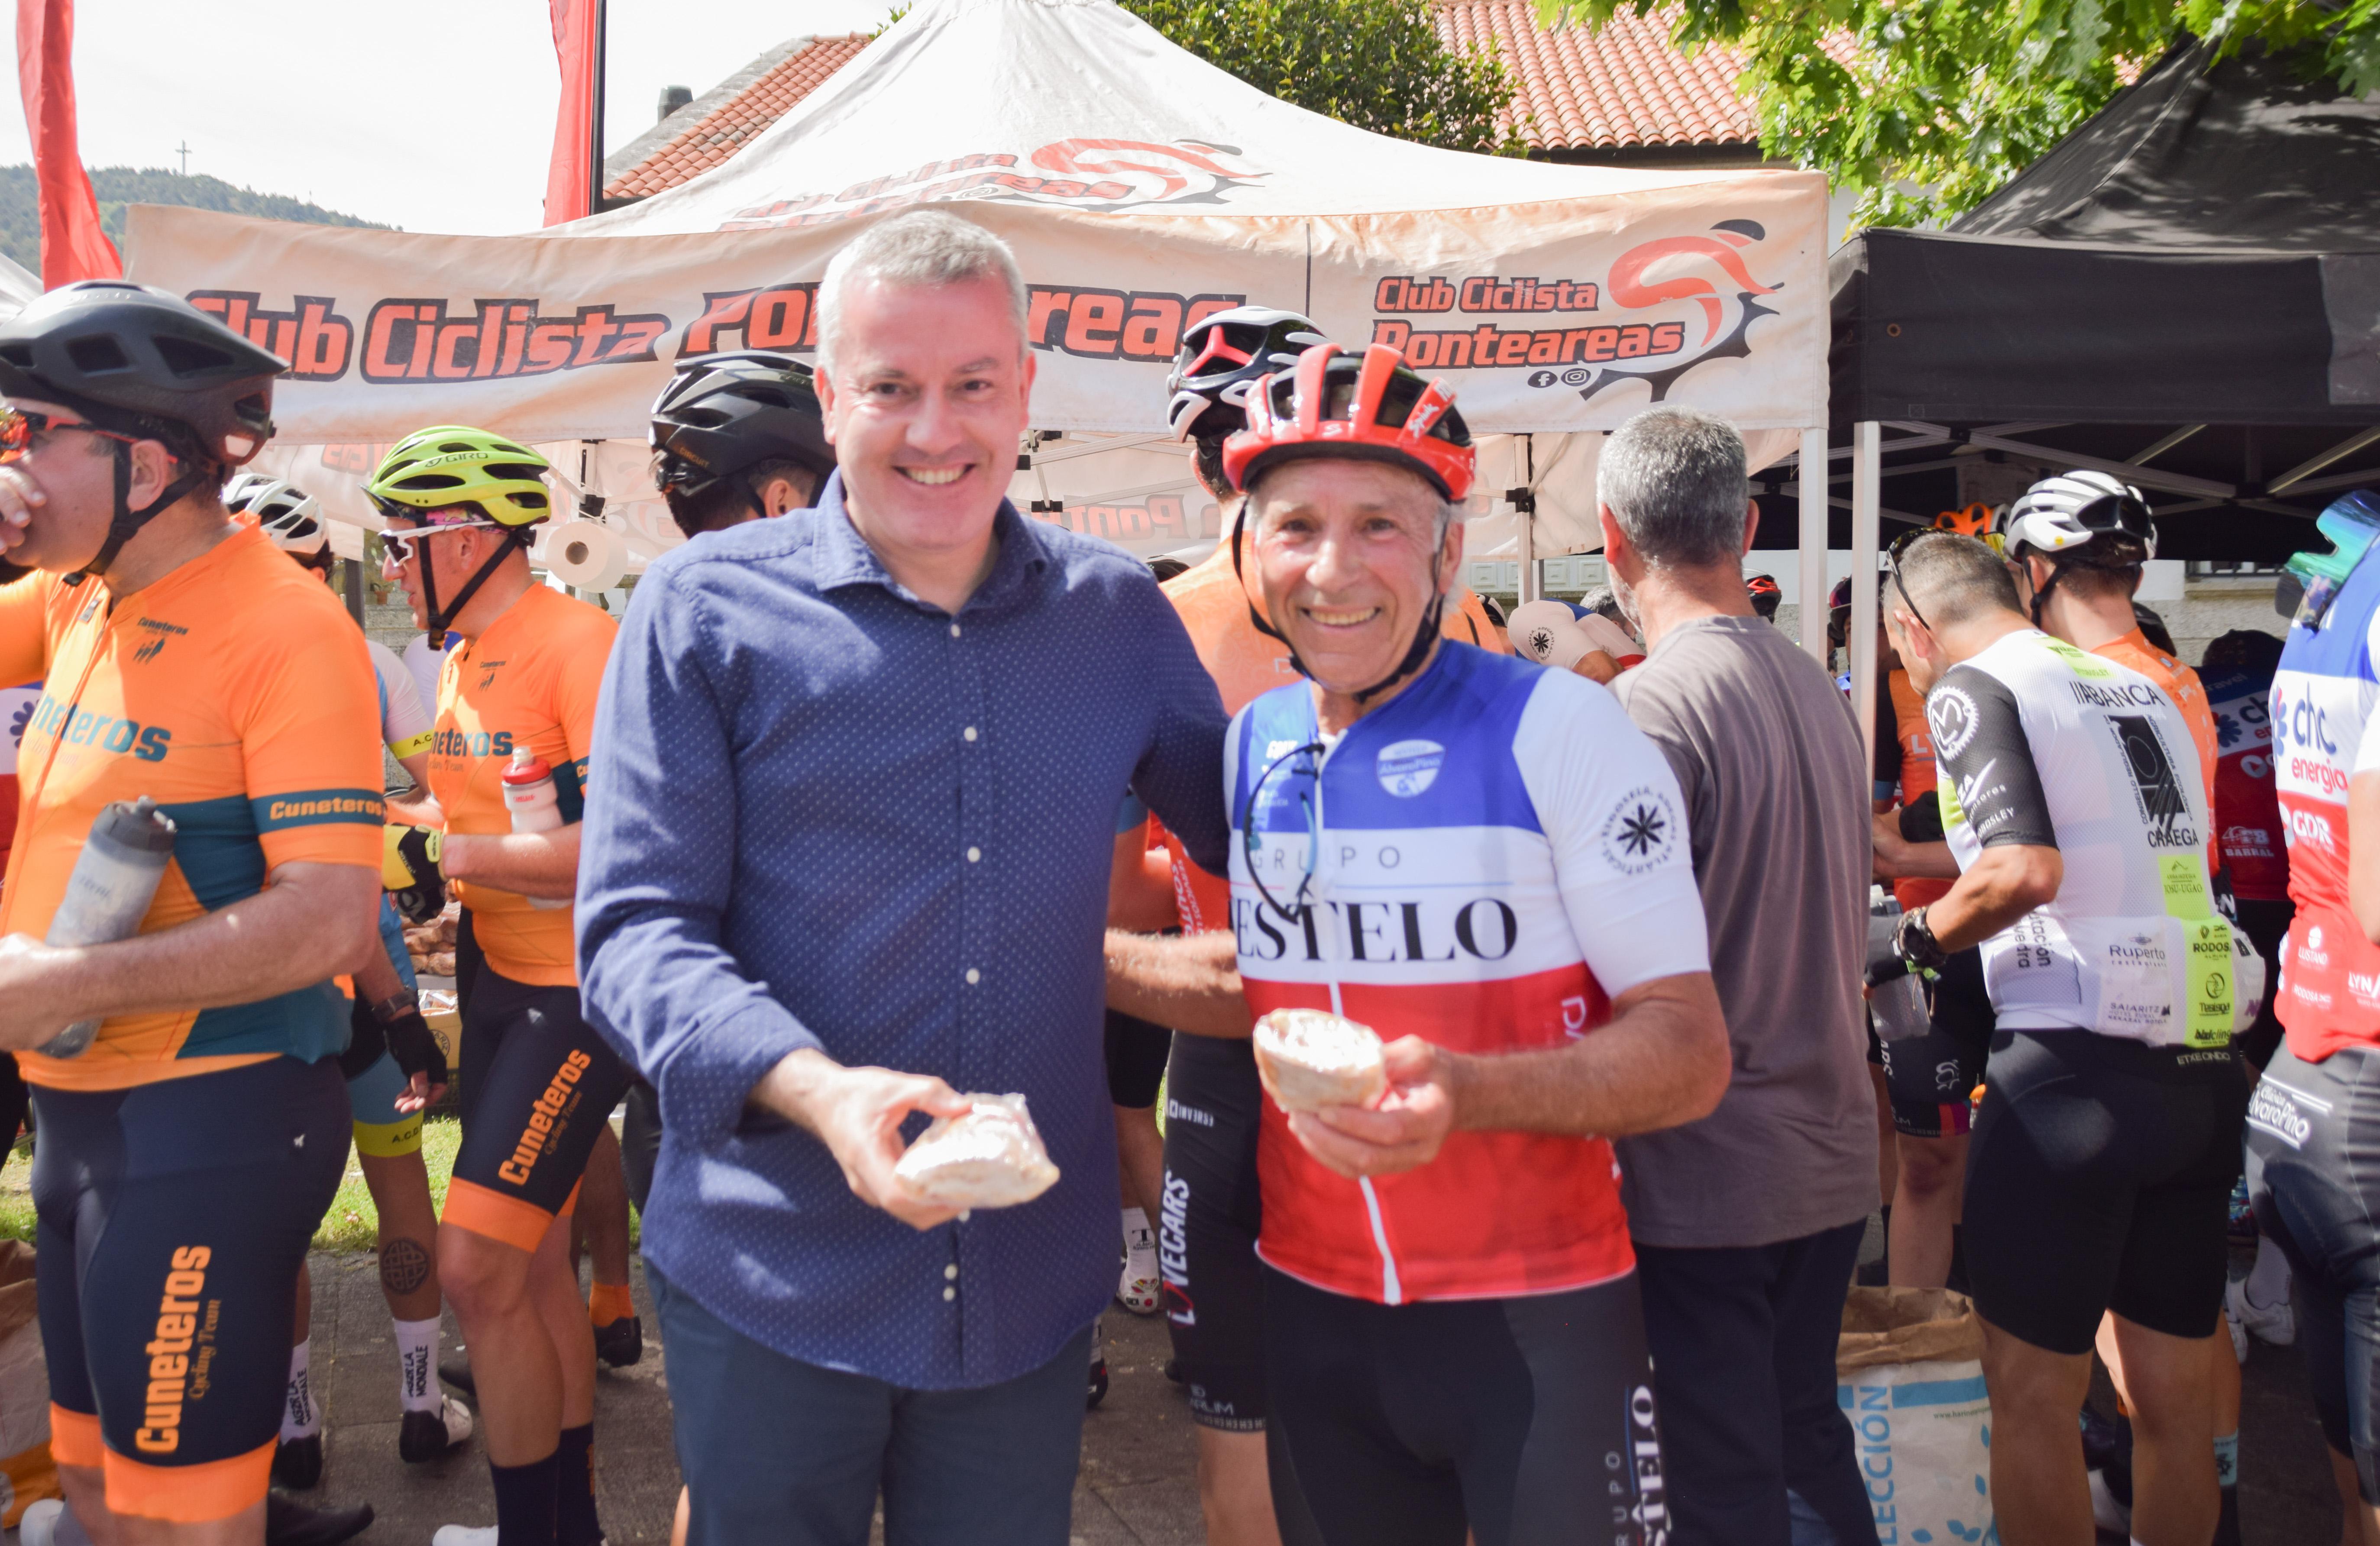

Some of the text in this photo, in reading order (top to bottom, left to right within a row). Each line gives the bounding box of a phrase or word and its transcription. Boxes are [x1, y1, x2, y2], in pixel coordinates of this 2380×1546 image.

[1374, 276, 1599, 313] Club Ciclista
[360, 298, 672, 384] Ciclista
[1372, 320, 1685, 369] Ponteareas
[446, 452, 488, 463] GIRO
[2292, 681, 2337, 755] chc
[270, 798, 383, 820] Cuneteros
[2292, 809, 2334, 845] GDR
[2147, 828, 2200, 848] CRAEGA
[2109, 944, 2165, 960] Ruperto
[498, 1048, 592, 1186] Cuneteros
[135, 1245, 211, 1453] Cuneteros
[414, 1345, 429, 1398] MONDIALE
